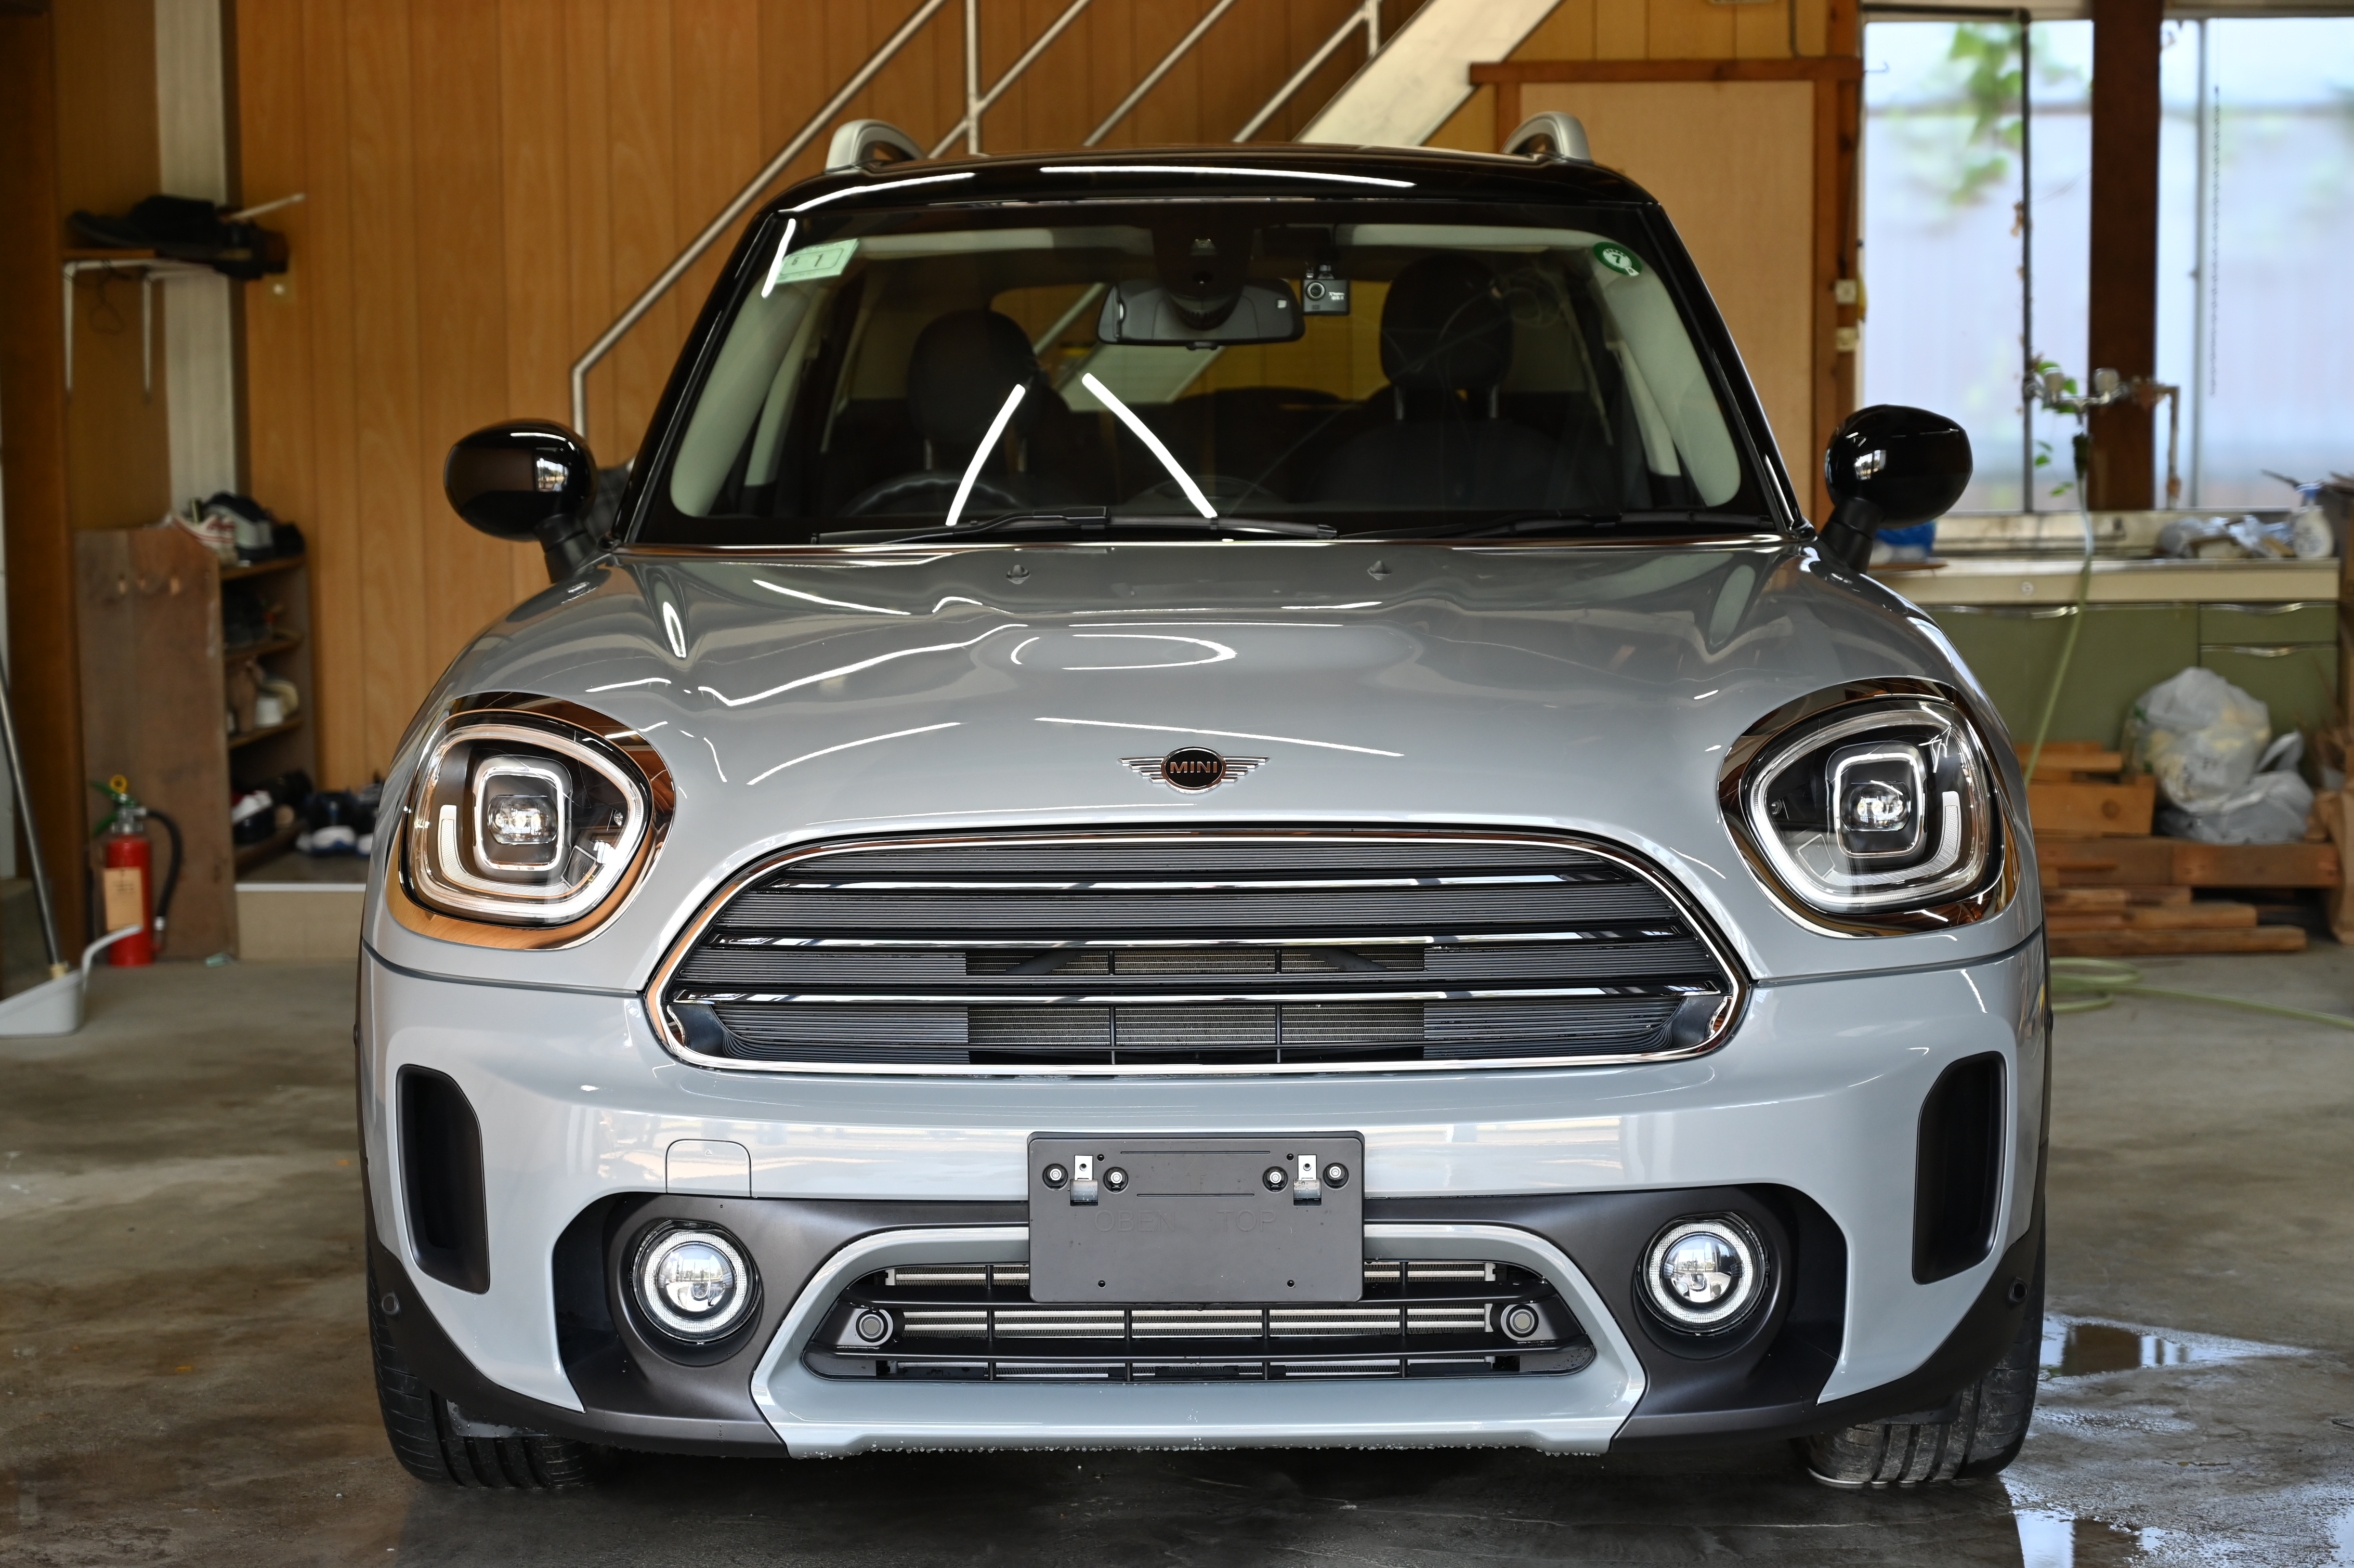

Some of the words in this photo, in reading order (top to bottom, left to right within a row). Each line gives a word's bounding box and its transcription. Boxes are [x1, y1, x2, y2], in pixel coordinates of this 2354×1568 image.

[1612, 254, 1621, 264] 7
[1170, 761, 1218, 773] MINI
[1094, 1209, 1176, 1232] OBEN
[1217, 1209, 1277, 1232] TOP
